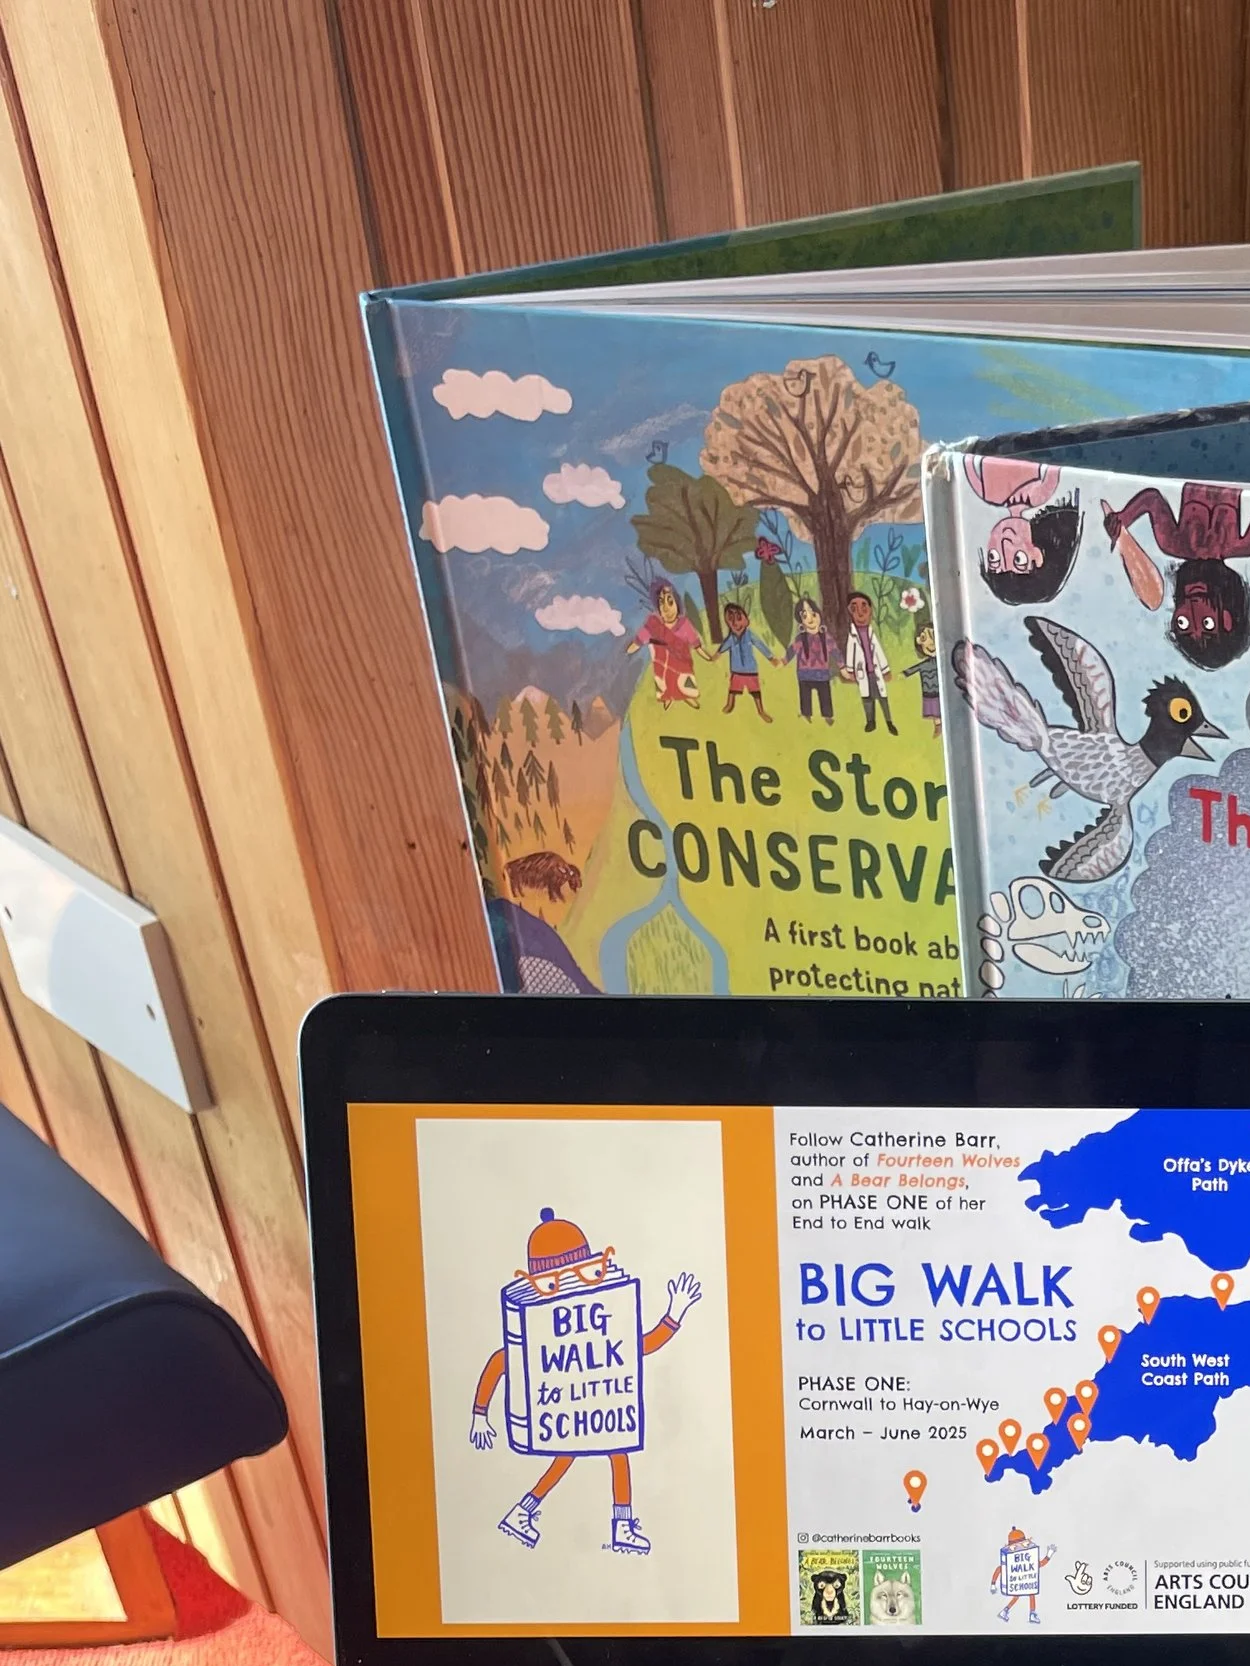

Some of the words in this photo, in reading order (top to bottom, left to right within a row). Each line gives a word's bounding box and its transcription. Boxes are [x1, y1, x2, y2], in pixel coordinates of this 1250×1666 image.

[659, 736, 782, 806] The
[808, 749, 948, 821] Stor
[628, 819, 957, 906] CONSERVA
[764, 918, 781, 942] A
[789, 920, 846, 949] first
[854, 927, 918, 956] book
[928, 936, 959, 960] ab
[769, 963, 909, 997] protecting
[918, 978, 961, 998] nat
[790, 1132, 842, 1147] Follow
[850, 1132, 946, 1147] Catherine
[955, 1132, 1000, 1149] Barr,
[791, 1153, 845, 1167] author
[853, 1153, 869, 1167] of
[877, 1154, 953, 1168] Fourteen
[962, 1154, 1020, 1168] Wolves
[791, 1173, 823, 1186] and
[831, 1174, 842, 1186] A
[851, 1174, 891, 1187] Bear
[899, 1174, 969, 1190] Belongs,
[1192, 1177, 1228, 1191] Path
[792, 1198, 812, 1209] on
[820, 1195, 877, 1210] PHASE
[886, 1195, 927, 1210] ONE
[936, 1197, 952, 1210] of
[959, 1196, 986, 1210] her
[792, 1216, 823, 1229] End
[831, 1216, 847, 1229] to
[855, 1216, 884, 1229] End
[892, 1216, 931, 1230] walk
[800, 1263, 895, 1307] BIG
[921, 1262, 1074, 1308] WALK
[553, 1303, 612, 1337] BIG
[796, 1318, 826, 1342] to
[840, 1317, 924, 1342] LITTLE
[939, 1318, 1077, 1342] SCHOOLS
[541, 1340, 624, 1373] WALK
[1141, 1354, 1186, 1368] South
[1192, 1354, 1230, 1368] West
[799, 1376, 855, 1391] PHASE
[865, 1376, 911, 1392] ONE:
[1141, 1373, 1188, 1386] Coast
[1194, 1373, 1230, 1386] Path
[537, 1382, 564, 1406] to
[570, 1376, 634, 1401] LITTLE
[799, 1397, 873, 1411] Cornwall
[880, 1399, 896, 1411] to
[904, 1398, 999, 1414] Hay-on-Wye
[539, 1405, 636, 1442] SCHOOLS
[800, 1425, 855, 1440] March
[880, 1426, 920, 1440] June
[928, 1426, 967, 1440] 2025
[1014, 1553, 1031, 1562] BIG
[1154, 1560, 1195, 1569] Supported
[1197, 1560, 1217, 1569] using
[1219, 1560, 1243, 1569] public
[1011, 1563, 1034, 1573] WALK
[1009, 1582, 1038, 1592] SCHOOLS
[1155, 1574, 1203, 1590] ARTS
[1155, 1595, 1244, 1610] ENGLAND
